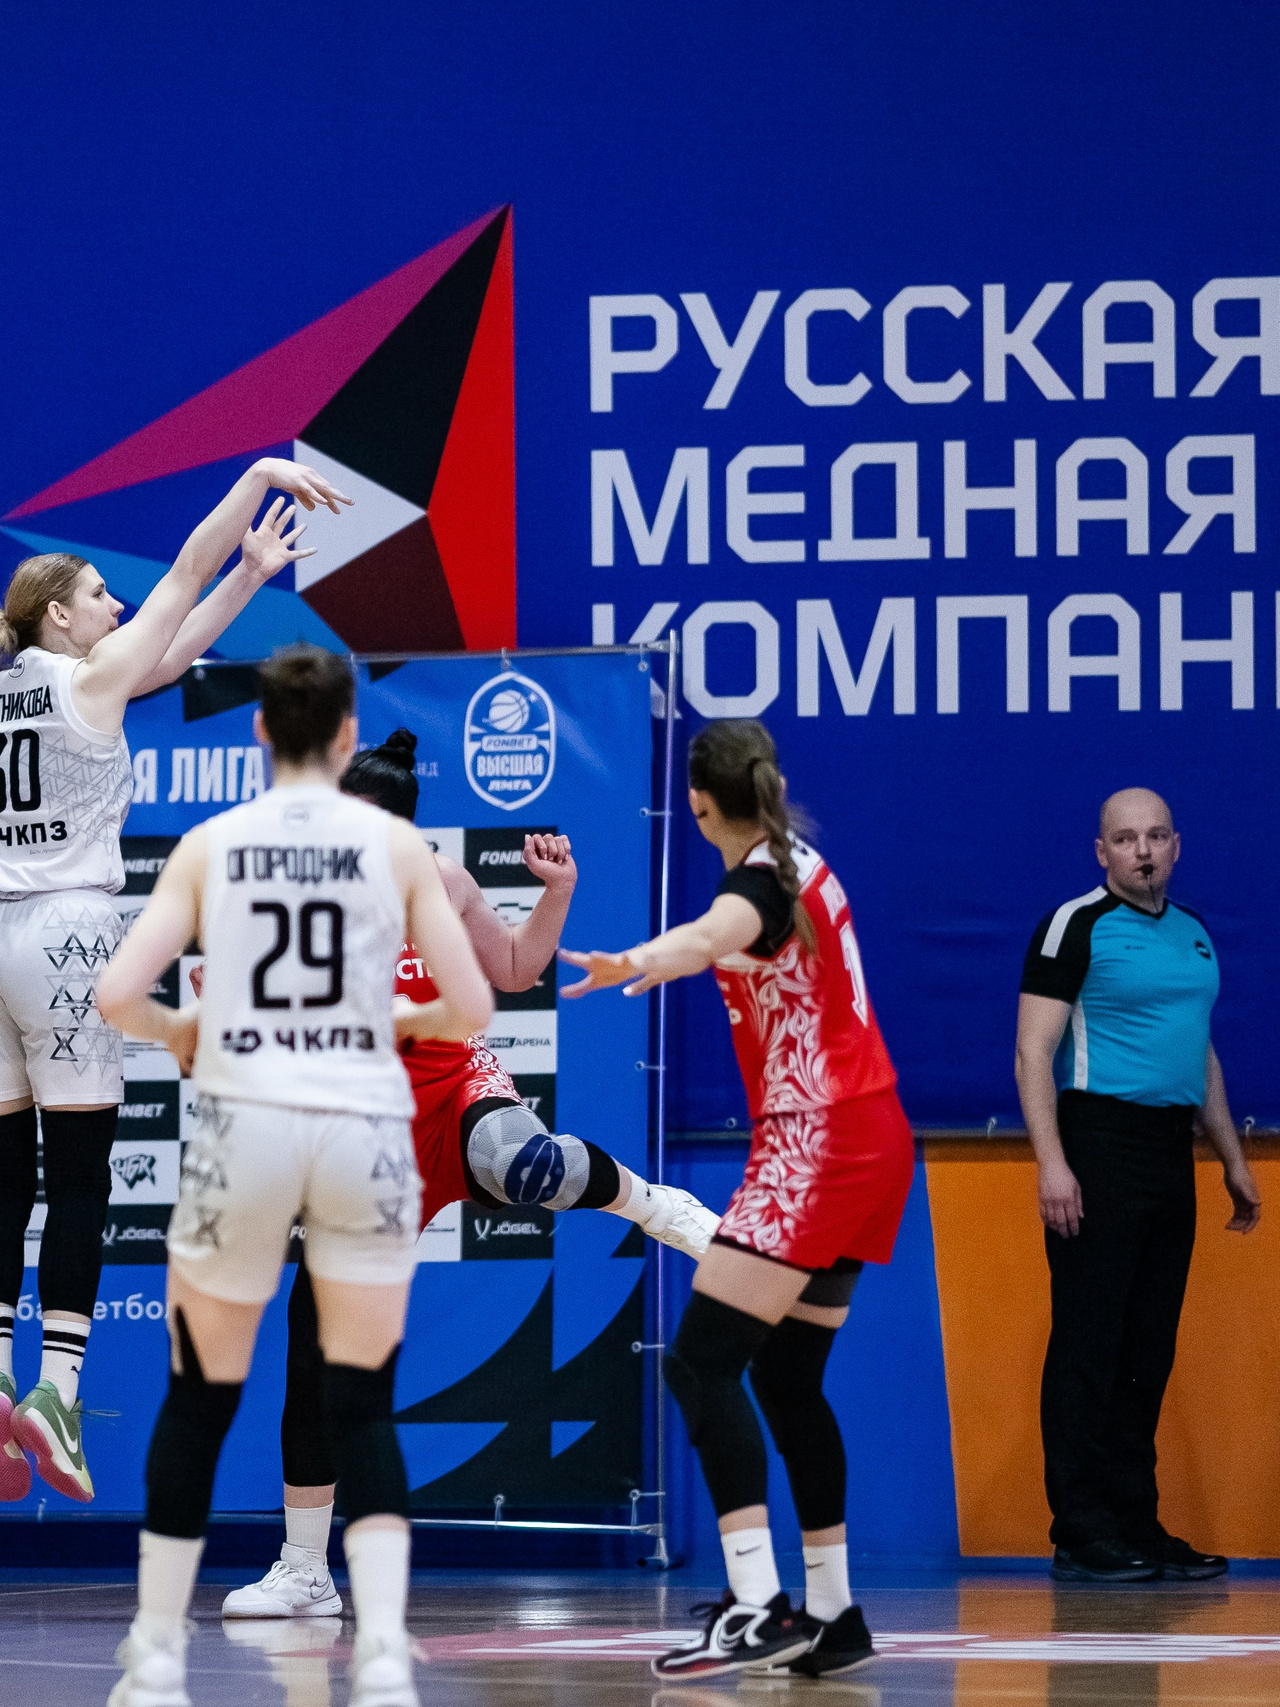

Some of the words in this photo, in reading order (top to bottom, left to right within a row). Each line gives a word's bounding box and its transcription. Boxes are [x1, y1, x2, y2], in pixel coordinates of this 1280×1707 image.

[589, 276, 1280, 412] РУССКАЯ
[590, 434, 1256, 567] МЕДНАЯ
[591, 591, 1280, 719] ОМПАН
[485, 738, 533, 748] FONBET
[167, 745, 266, 804] ЛИГА
[476, 754, 544, 777] ВЫСШАЯ
[487, 779, 533, 791] ЛИГА
[227, 846, 366, 886] ОГОРОДНИК
[250, 900, 344, 1011] 29
[274, 1026, 376, 1053] ЧКПЗ
[487, 1037, 512, 1048] РМК
[515, 1037, 551, 1047] АРЕНА
[490, 1219, 542, 1235] JÖGEL
